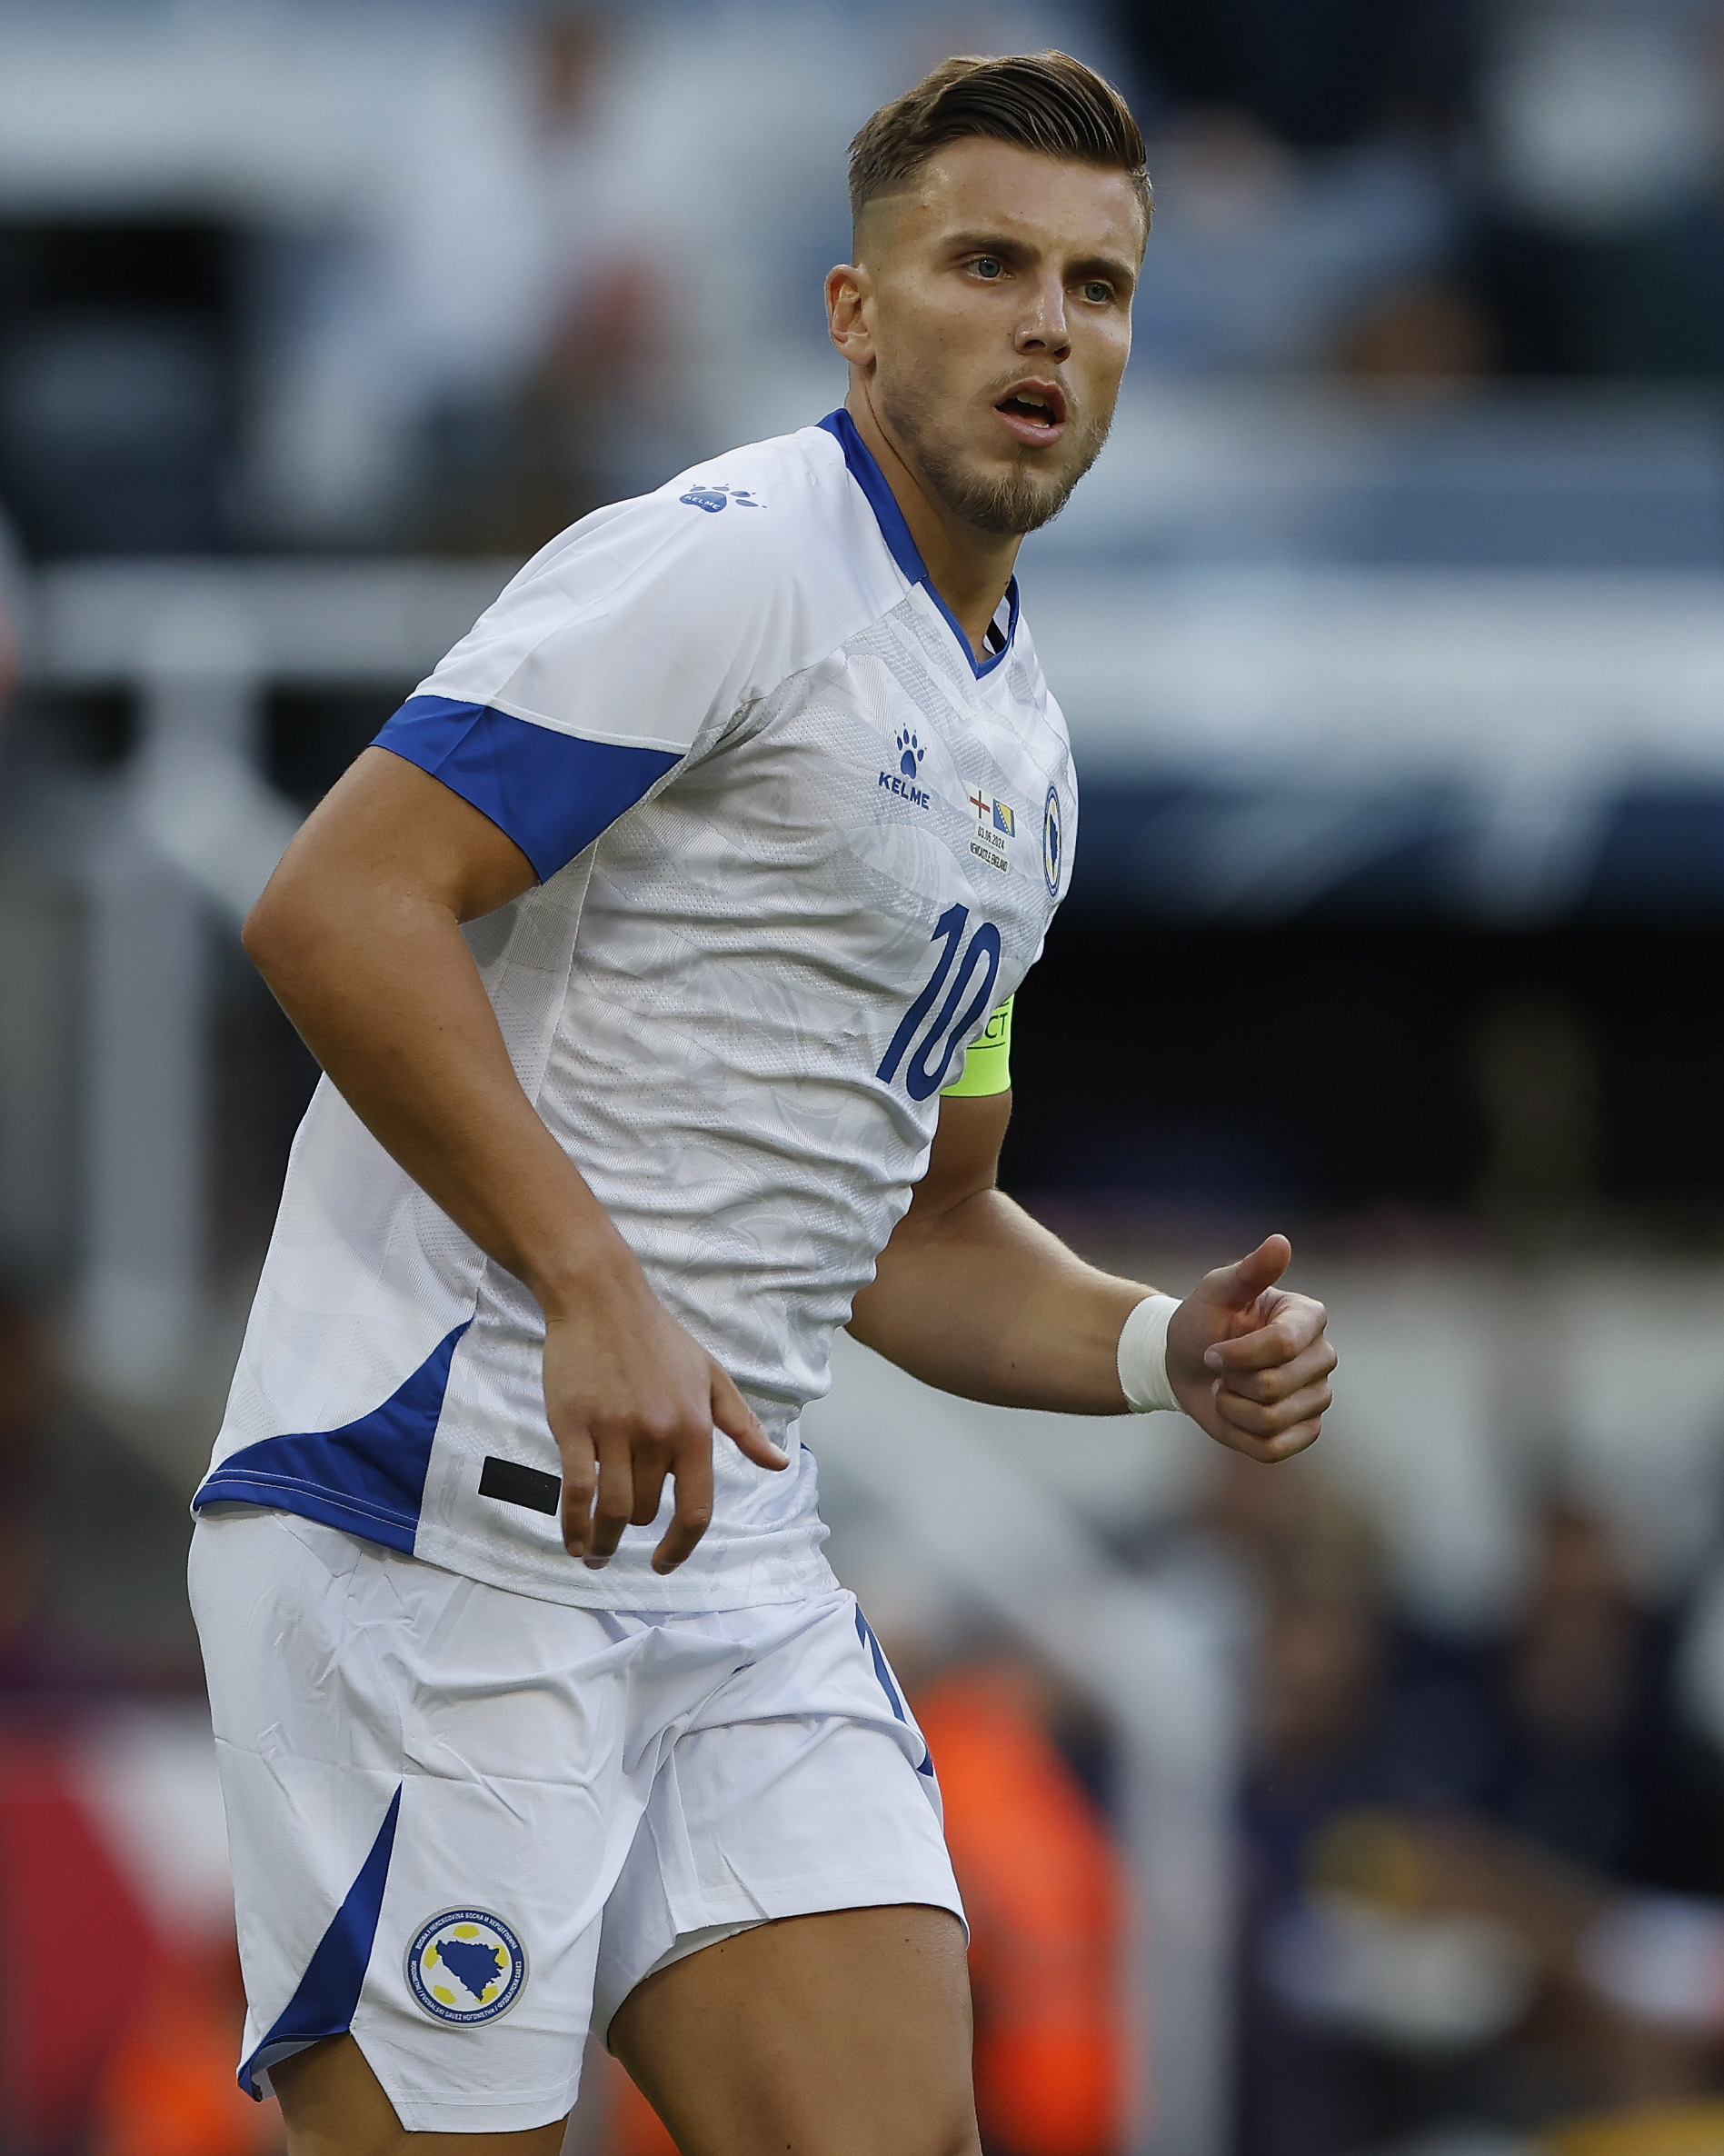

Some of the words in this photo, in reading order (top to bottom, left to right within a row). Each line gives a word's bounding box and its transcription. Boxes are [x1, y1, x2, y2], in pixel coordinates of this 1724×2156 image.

[878, 771, 931, 811] KELME
[875, 903, 1002, 1102] 10
[984, 1012, 1008, 1039] CT
